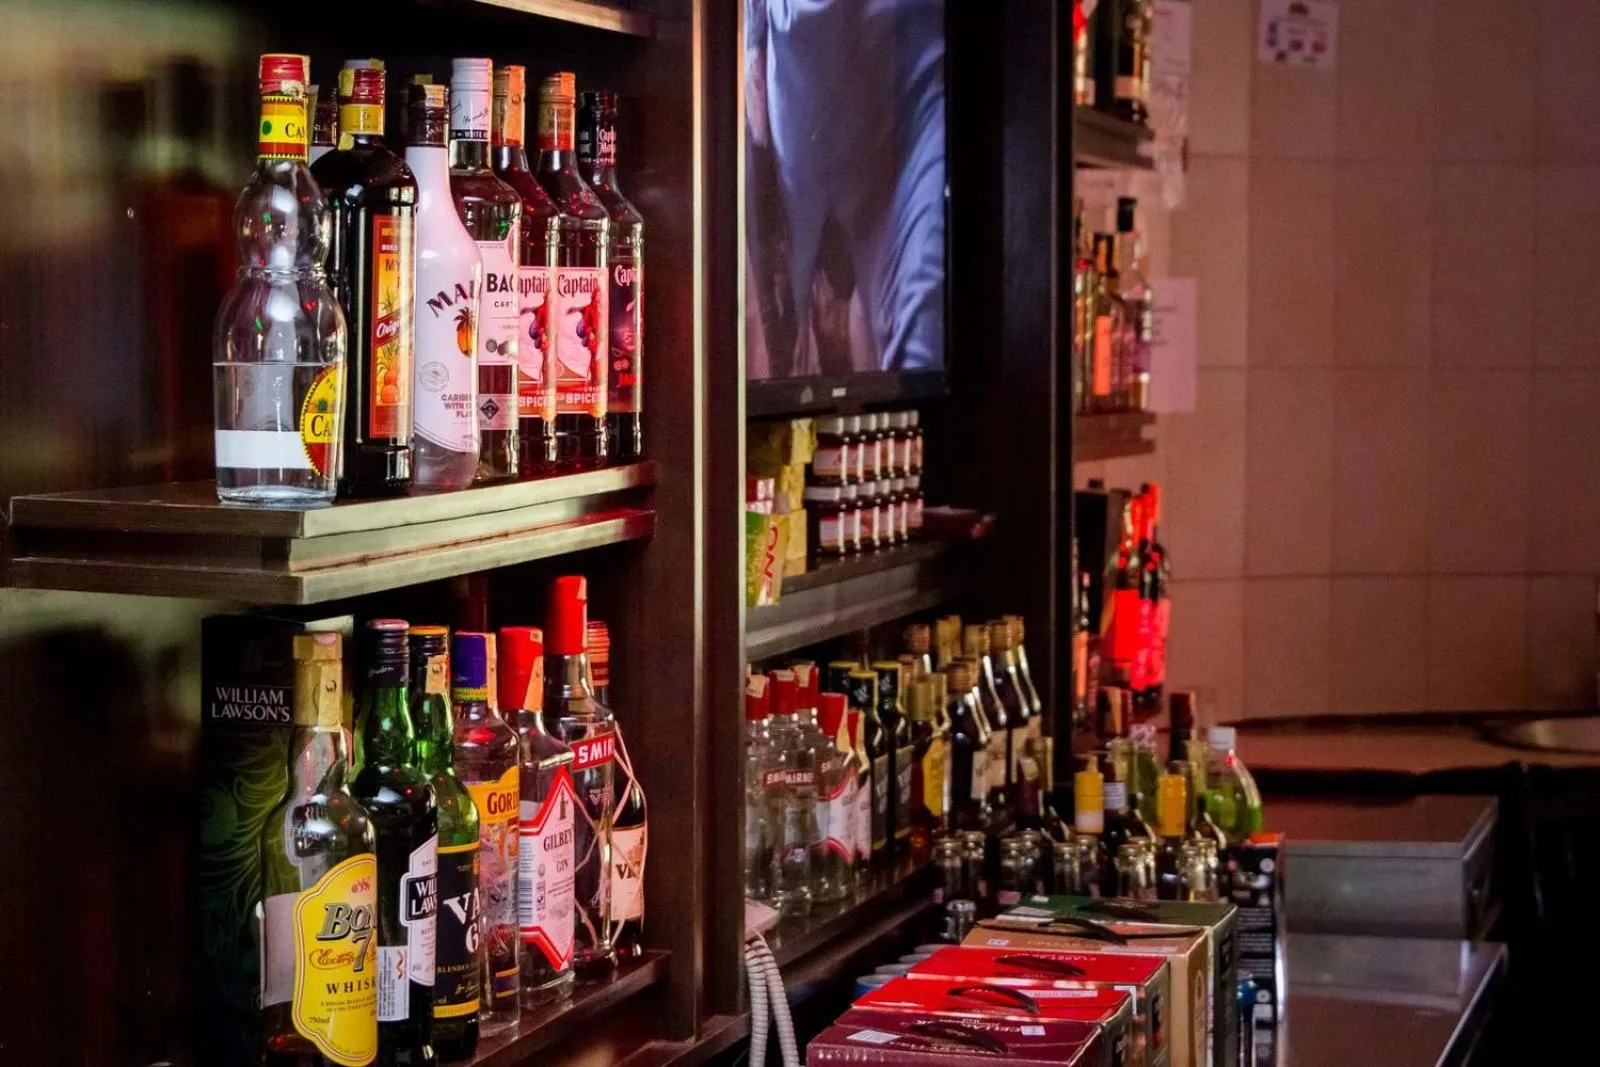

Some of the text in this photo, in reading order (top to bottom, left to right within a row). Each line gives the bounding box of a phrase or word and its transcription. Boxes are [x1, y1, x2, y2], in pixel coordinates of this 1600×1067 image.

[215, 686, 285, 705] WILLIAM
[211, 702, 291, 722] LAWSON'S
[556, 859, 569, 873] GIN
[352, 929, 372, 973] 7
